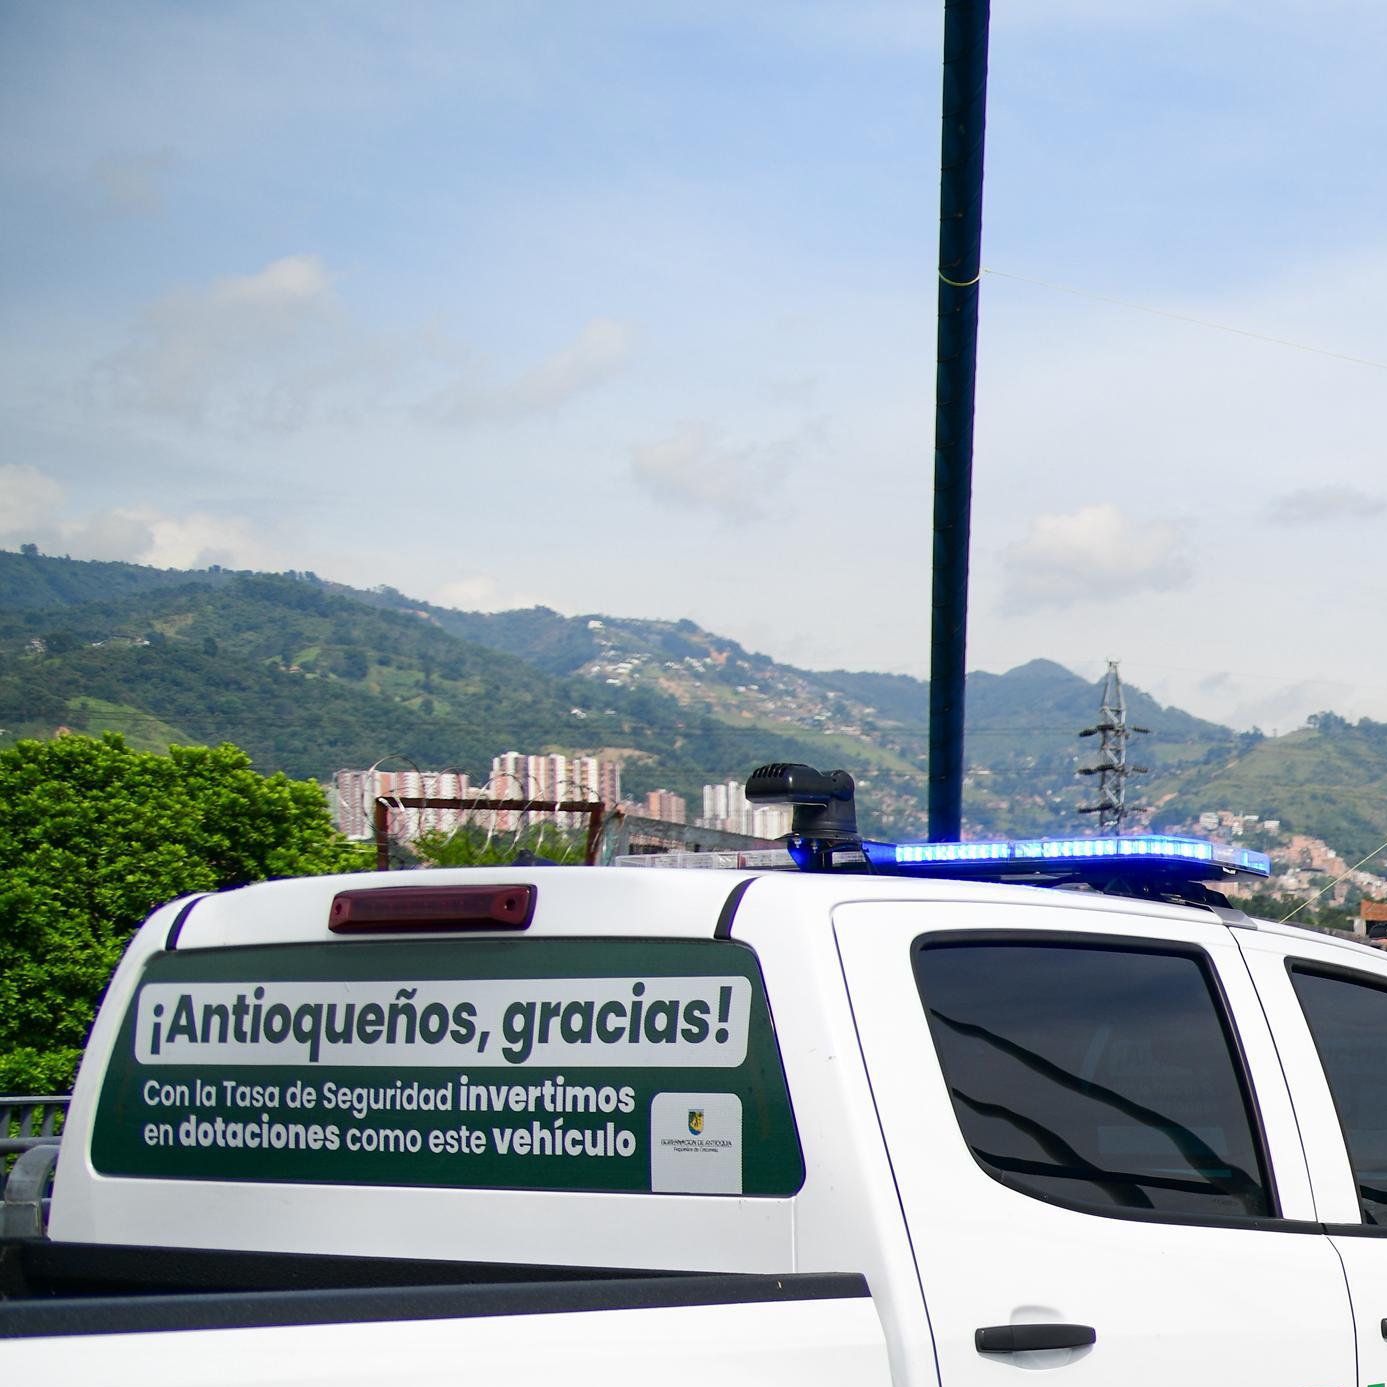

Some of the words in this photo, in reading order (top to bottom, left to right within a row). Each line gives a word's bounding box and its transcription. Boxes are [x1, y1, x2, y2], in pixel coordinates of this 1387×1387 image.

[150, 986, 491, 1064] ¡Antioqueños,
[502, 982, 734, 1065] gracias!
[143, 1080, 189, 1107] Con
[196, 1079, 216, 1107] la
[223, 1081, 280, 1108] Tasa
[286, 1080, 317, 1109] de
[323, 1080, 453, 1117] Seguridad
[459, 1075, 636, 1113] invertimos
[144, 1124, 173, 1146] en
[179, 1113, 340, 1150] dotaciones
[346, 1128, 422, 1153] como
[428, 1125, 487, 1154] este
[492, 1116, 637, 1157] vehículo
